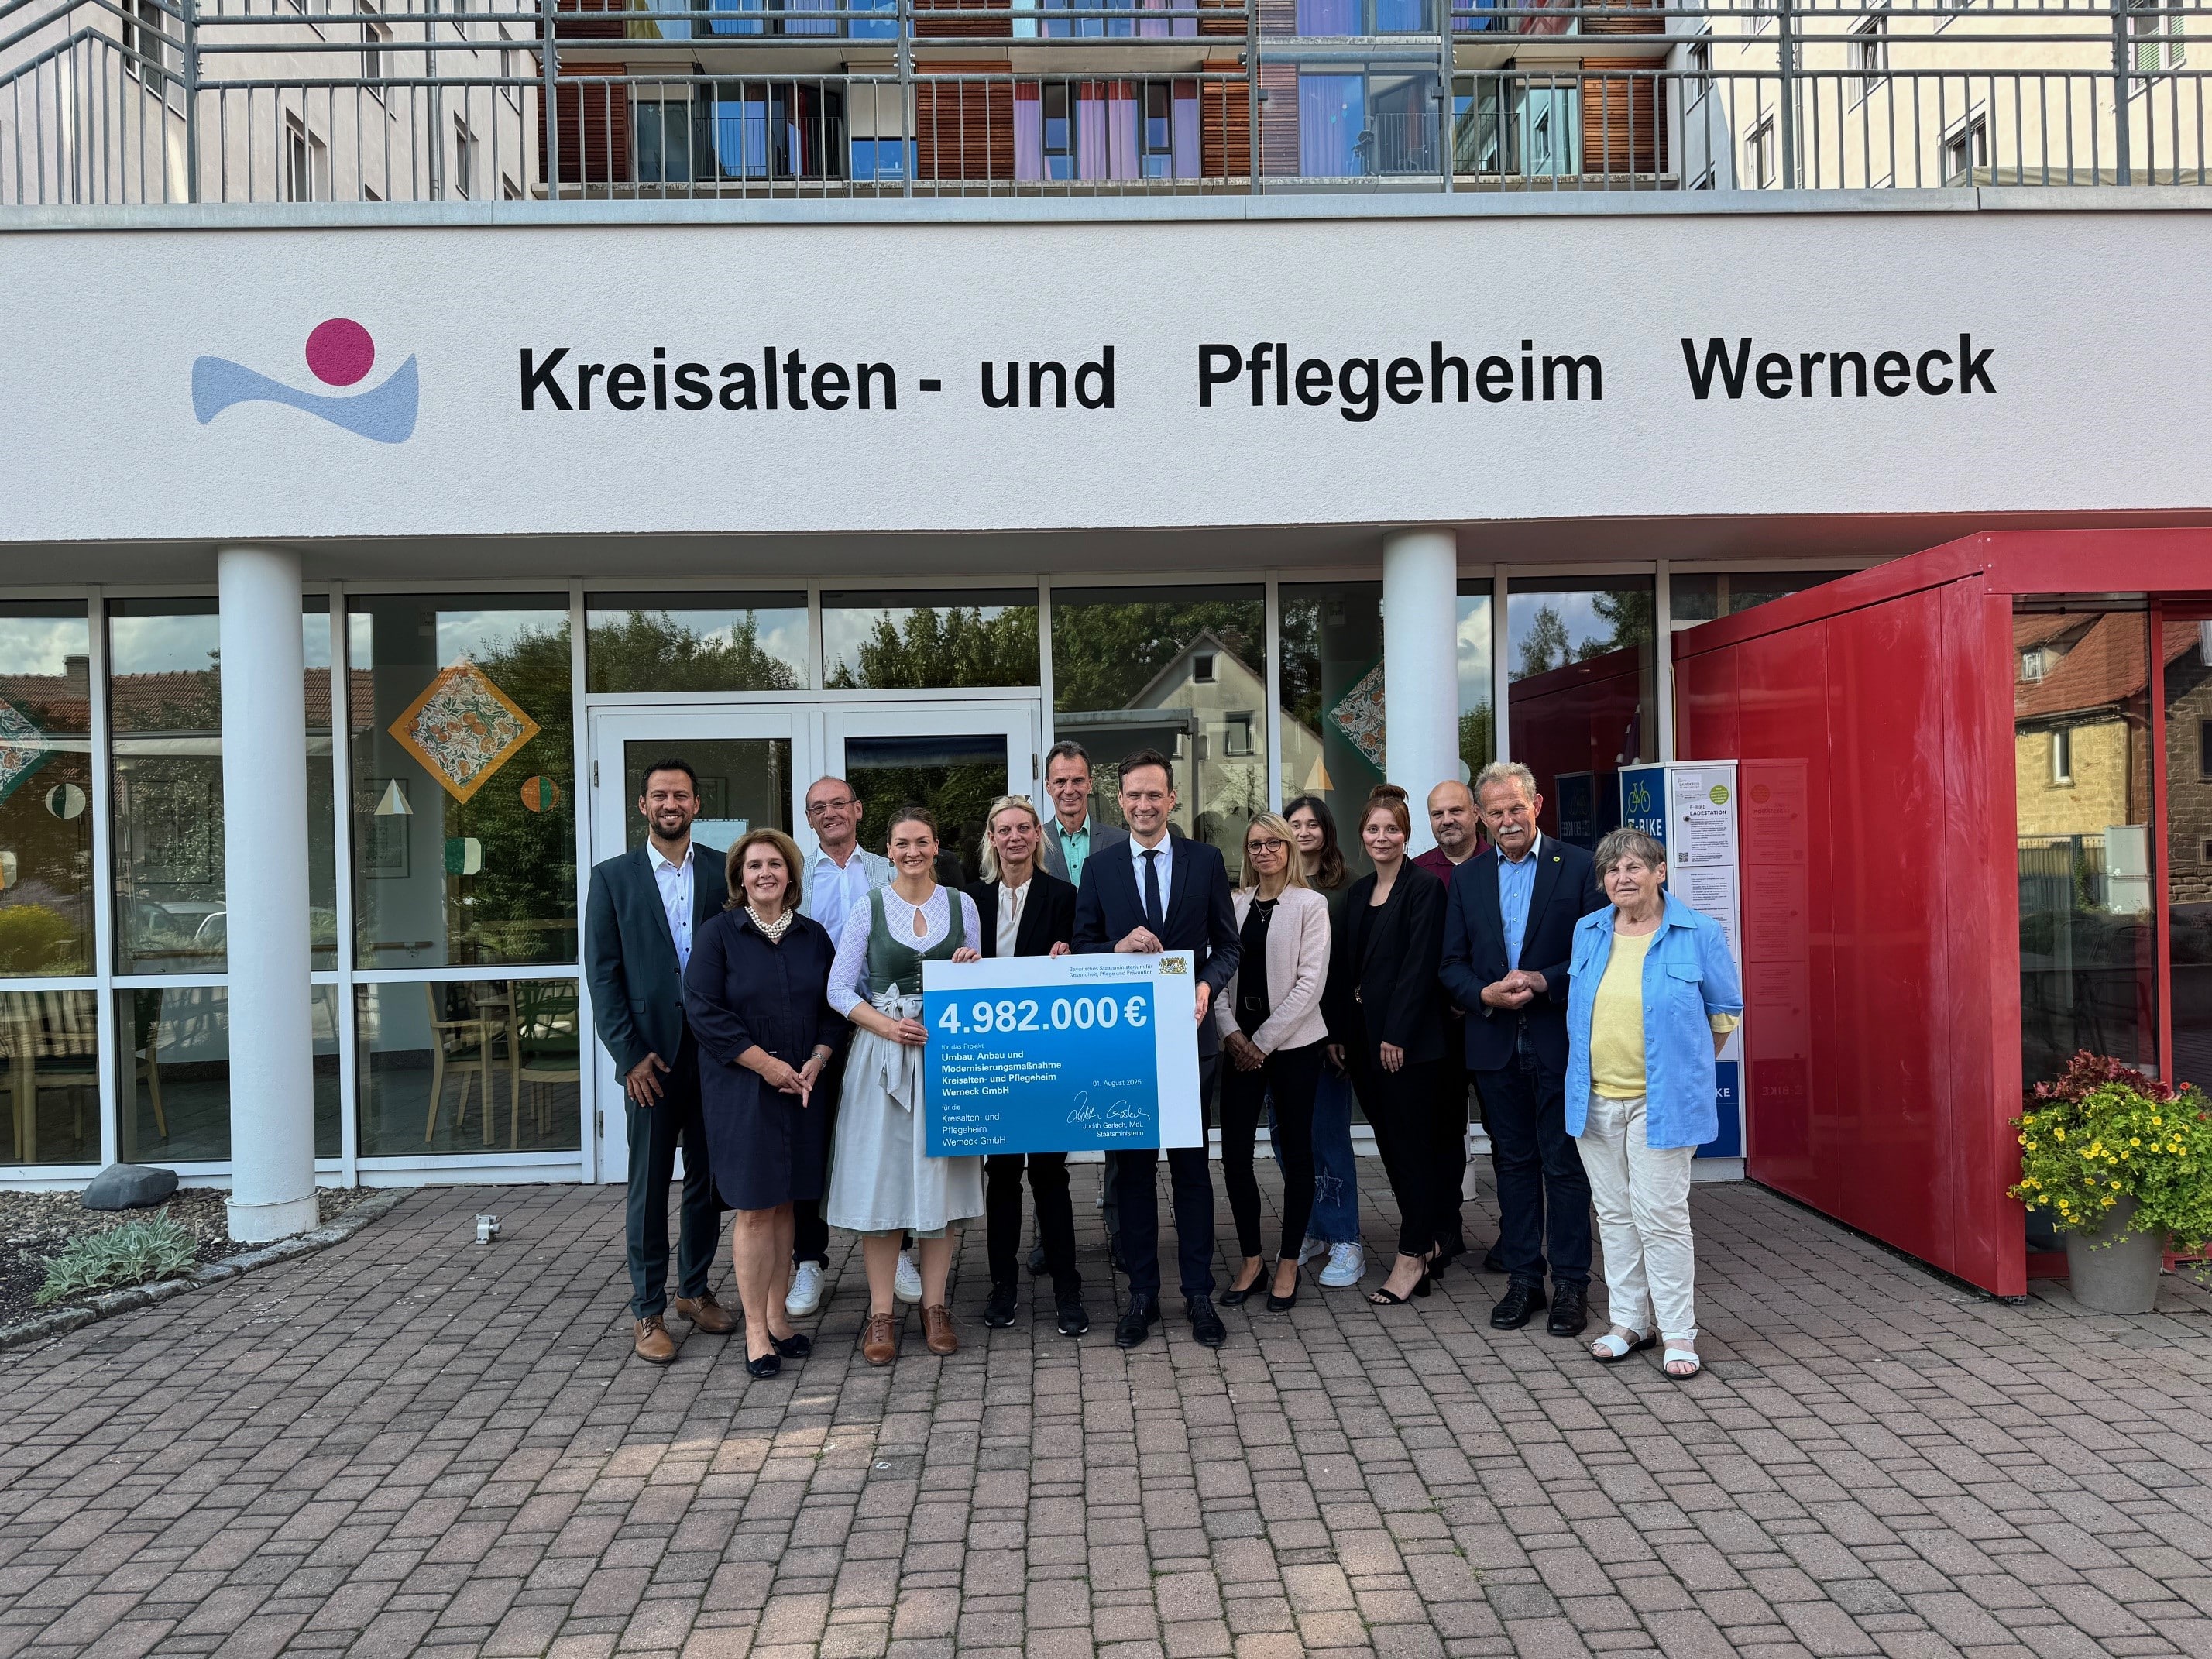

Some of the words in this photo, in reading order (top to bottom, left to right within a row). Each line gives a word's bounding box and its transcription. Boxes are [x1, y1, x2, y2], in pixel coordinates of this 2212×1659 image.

[520, 346, 897, 411] Kreisalten
[981, 345, 1115, 410] und
[1198, 341, 1602, 423] Pflegeheim
[1681, 334, 1997, 400] Werneck
[939, 996, 1118, 1034] 4.982.000
[1124, 995, 1147, 1027] €
[941, 1053, 975, 1061] Umbau,
[1007, 1050, 1024, 1059] und
[941, 1062, 1062, 1073] Modernisierungsmaßnahme
[942, 1076, 988, 1084] Kreisalten-
[990, 1074, 1006, 1083] und
[1008, 1073, 1056, 1084] Pflegeheim
[942, 1087, 979, 1097] Werneck
[981, 1086, 1009, 1095] GmbH
[942, 1114, 982, 1122] Kreisalten-
[942, 1125, 988, 1135] Pflegeheim
[942, 1138, 977, 1146] Werneck
[980, 1136, 1006, 1145] GmbH
